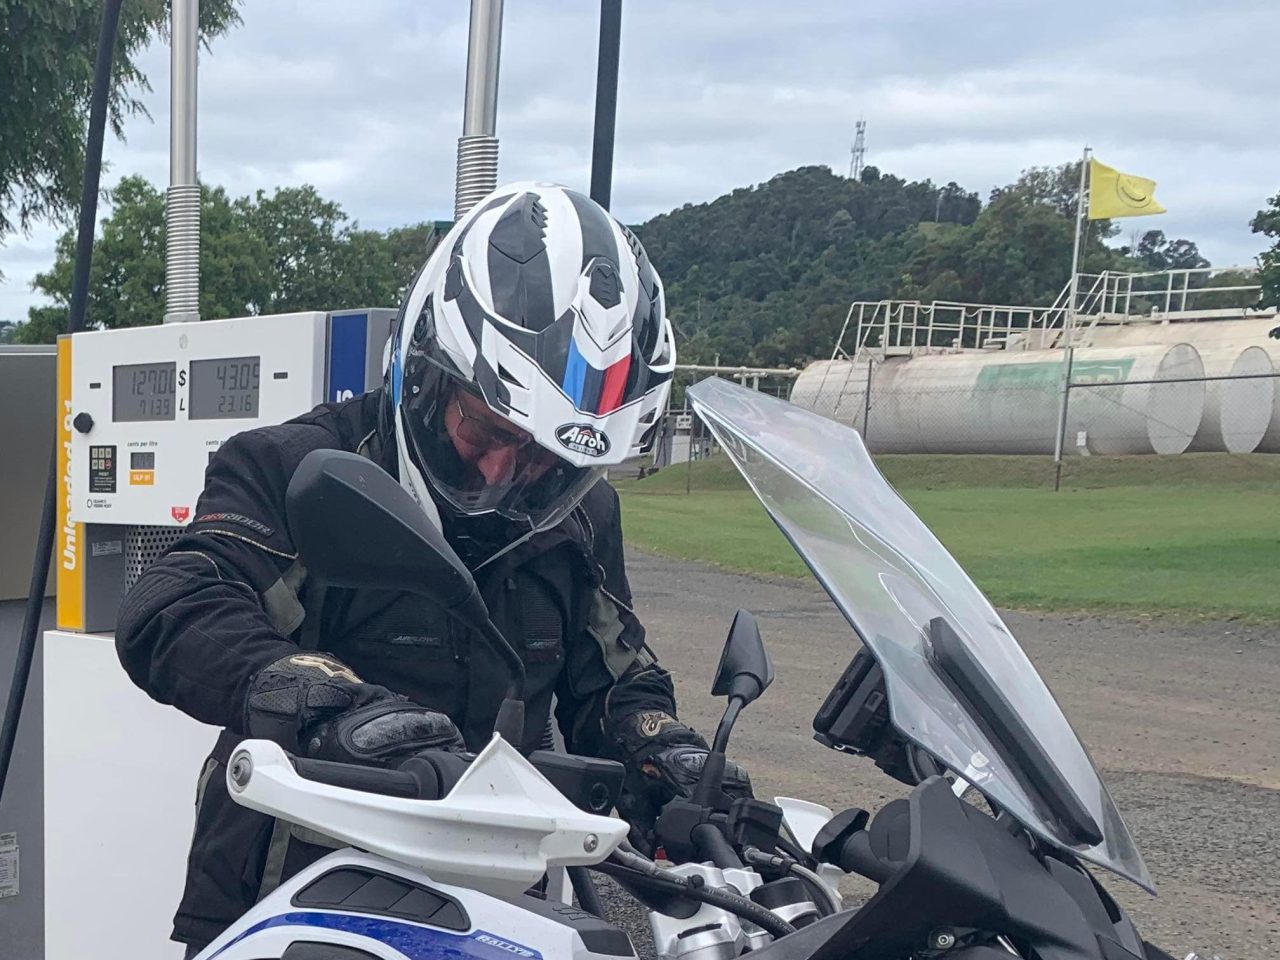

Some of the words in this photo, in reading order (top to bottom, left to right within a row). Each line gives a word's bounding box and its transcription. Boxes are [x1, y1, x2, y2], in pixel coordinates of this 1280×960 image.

[178, 370, 187, 387] $
[179, 397, 186, 412] L
[560, 426, 606, 452] Airoh
